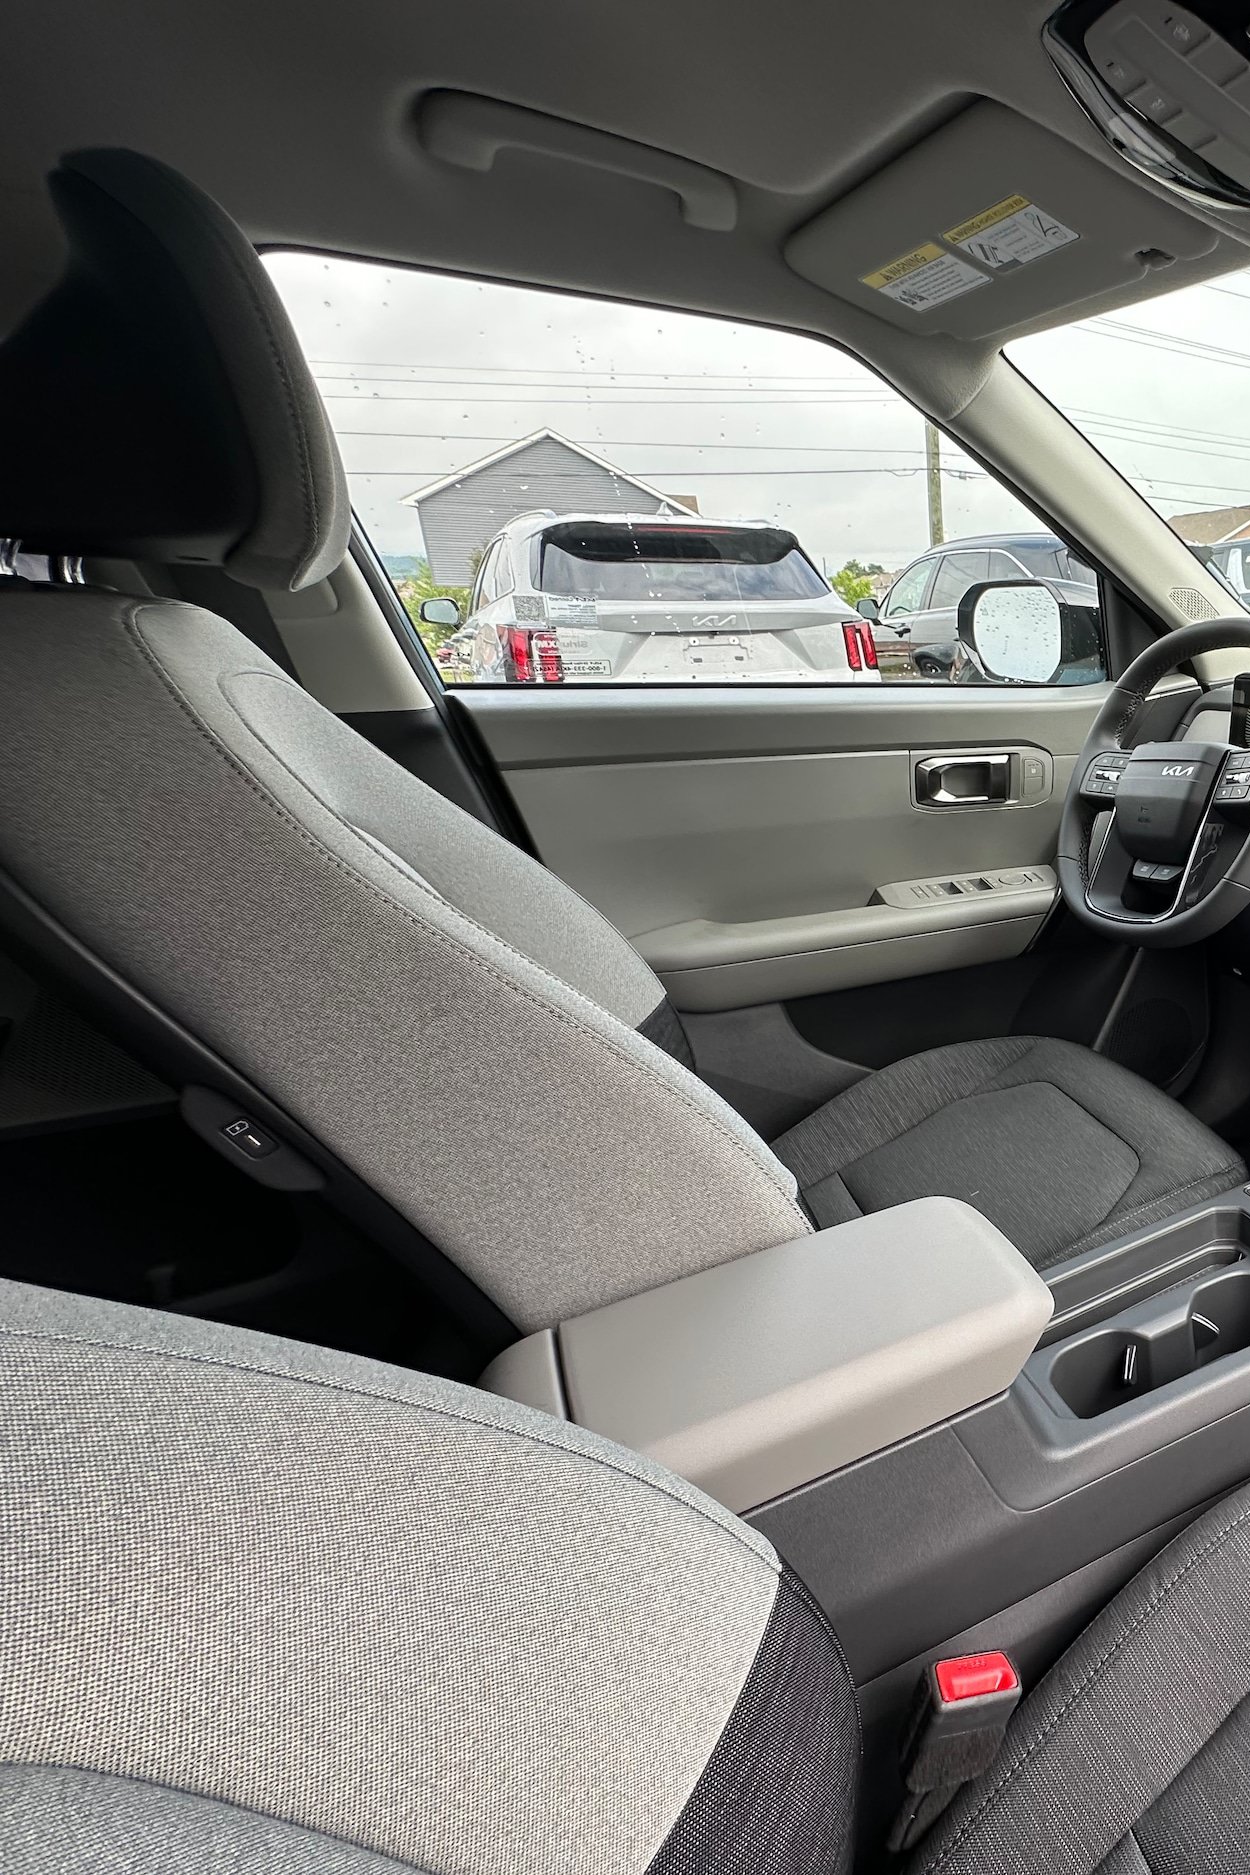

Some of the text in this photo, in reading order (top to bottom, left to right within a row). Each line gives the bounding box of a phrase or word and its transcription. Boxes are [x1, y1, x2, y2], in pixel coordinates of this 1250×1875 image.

[884, 253, 927, 277] WARNING
[692, 614, 737, 627] KIA
[1161, 765, 1195, 777] KIA
